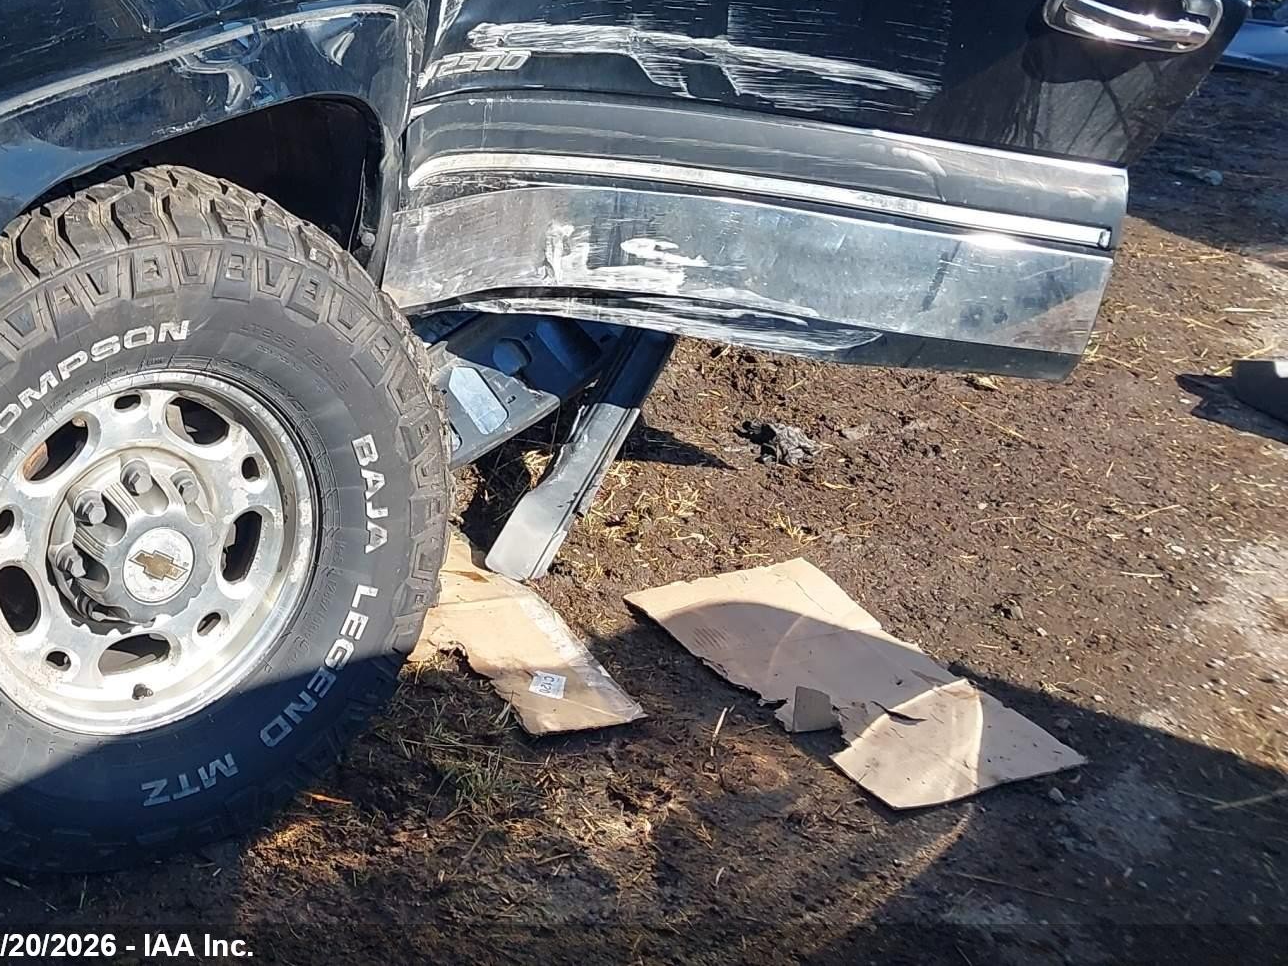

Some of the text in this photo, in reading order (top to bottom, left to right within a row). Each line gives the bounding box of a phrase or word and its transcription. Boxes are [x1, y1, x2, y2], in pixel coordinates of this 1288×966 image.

[351, 434, 390, 554] BAJA
[260, 586, 379, 748] LEGEND
[141, 752, 239, 806] MTZ
